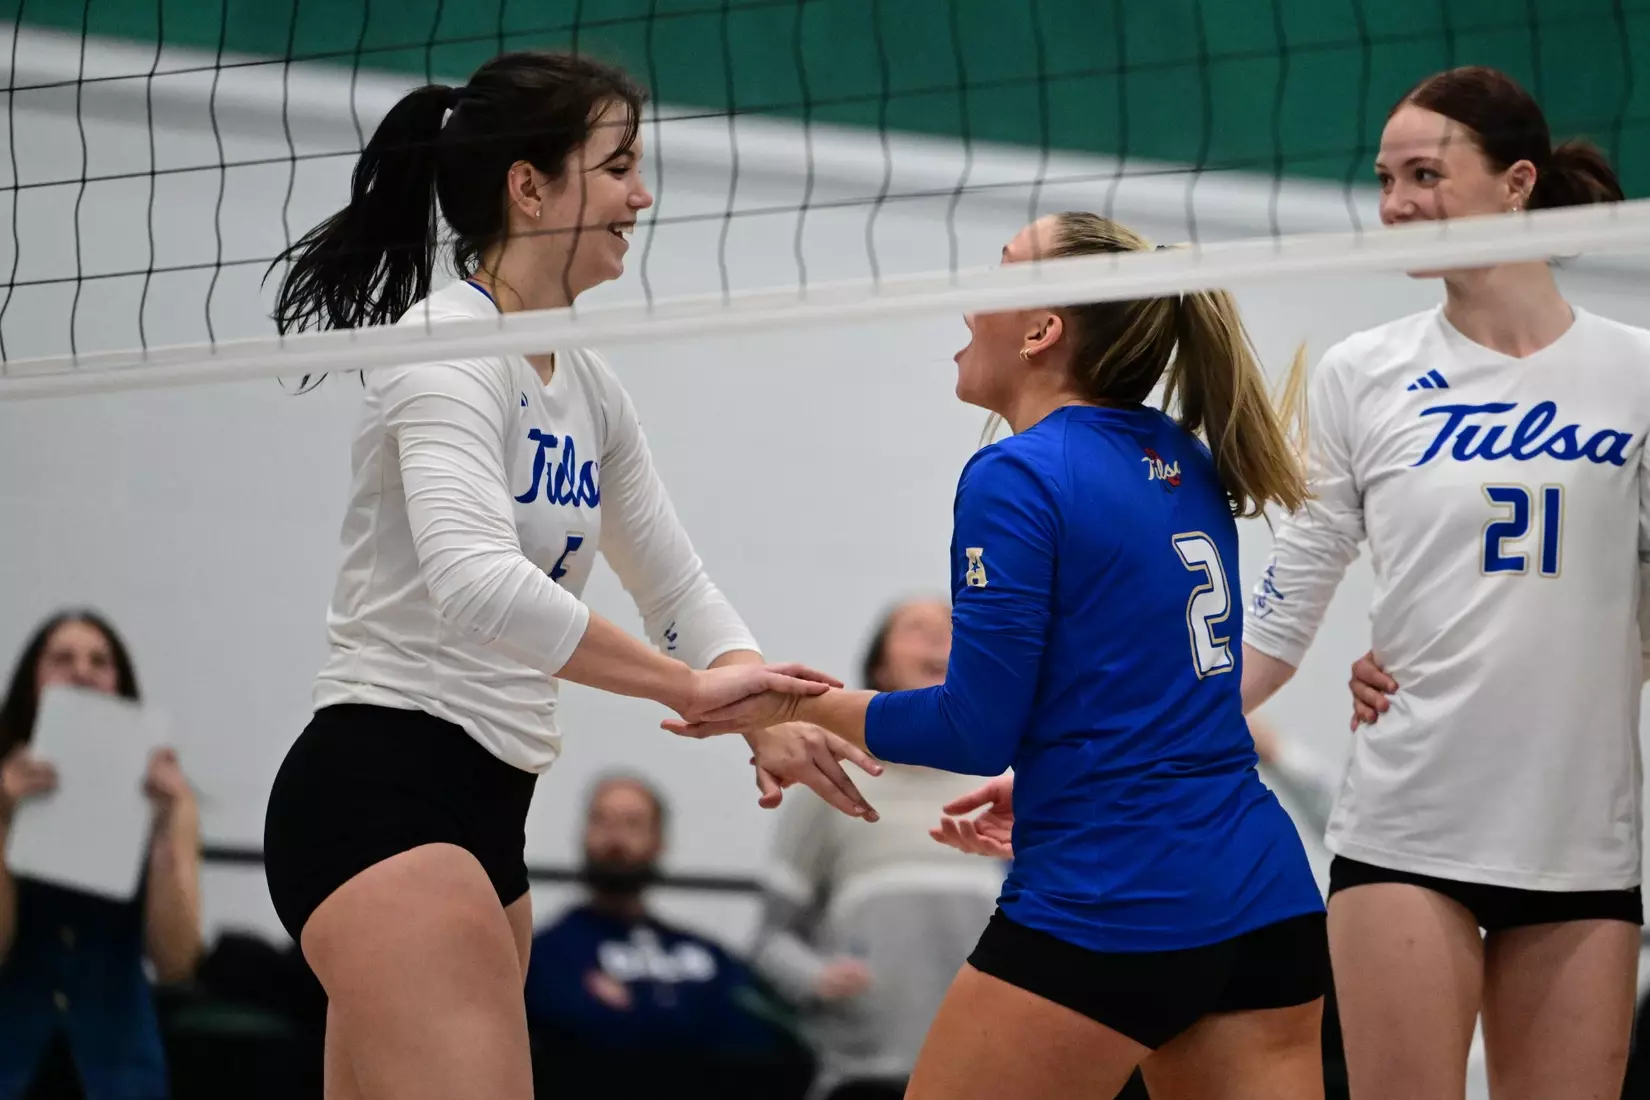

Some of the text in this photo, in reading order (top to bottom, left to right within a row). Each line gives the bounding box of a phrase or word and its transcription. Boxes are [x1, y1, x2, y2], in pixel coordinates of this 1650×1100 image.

[514, 428, 600, 508] Tuls
[1410, 400, 1633, 467] Tulsa
[1481, 482, 1566, 578] 21
[1172, 531, 1234, 680] 2
